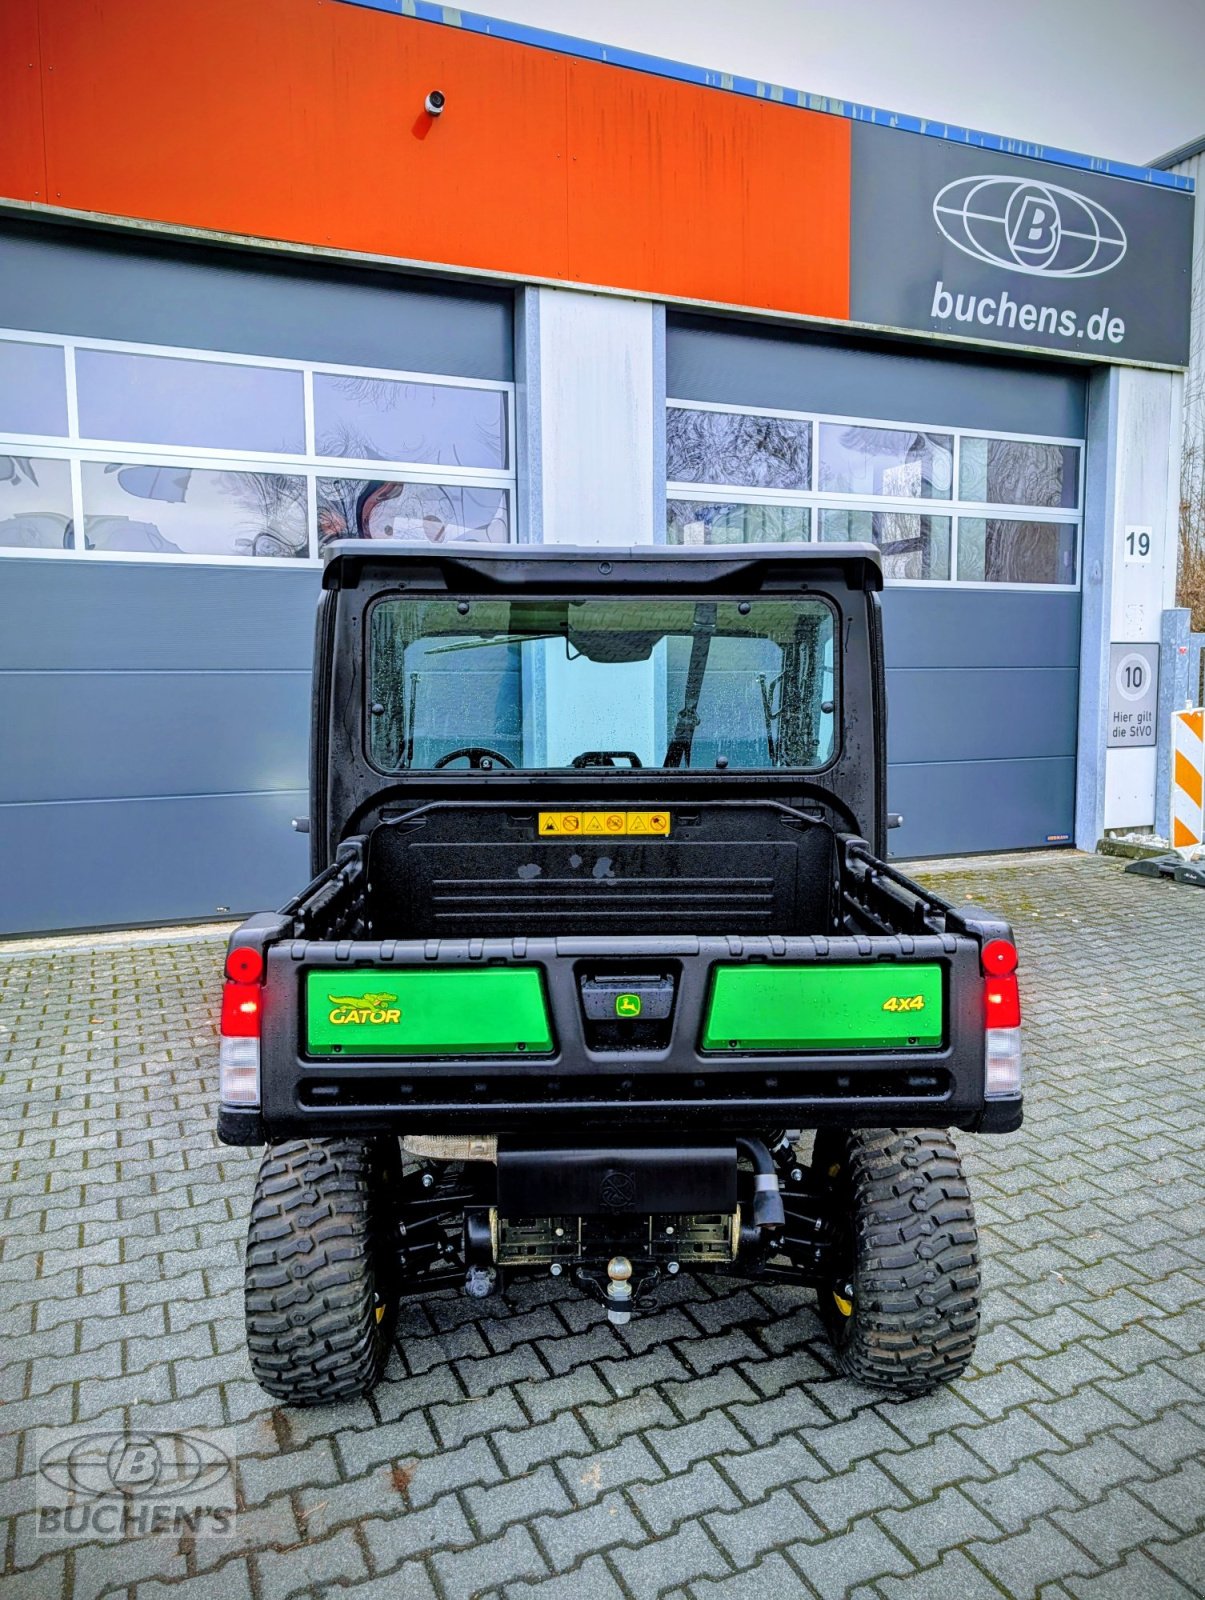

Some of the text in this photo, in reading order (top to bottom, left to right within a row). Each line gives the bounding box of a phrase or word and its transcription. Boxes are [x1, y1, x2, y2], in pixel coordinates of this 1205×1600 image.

[931, 281, 1125, 343] buchens.de
[1126, 532, 1150, 556] 19
[1125, 666, 1143, 688] 10
[1113, 710, 1152, 725] Hier gilt
[1112, 725, 1152, 738] die StVO
[882, 995, 925, 1012] 4x4
[328, 1008, 401, 1025] GATOR
